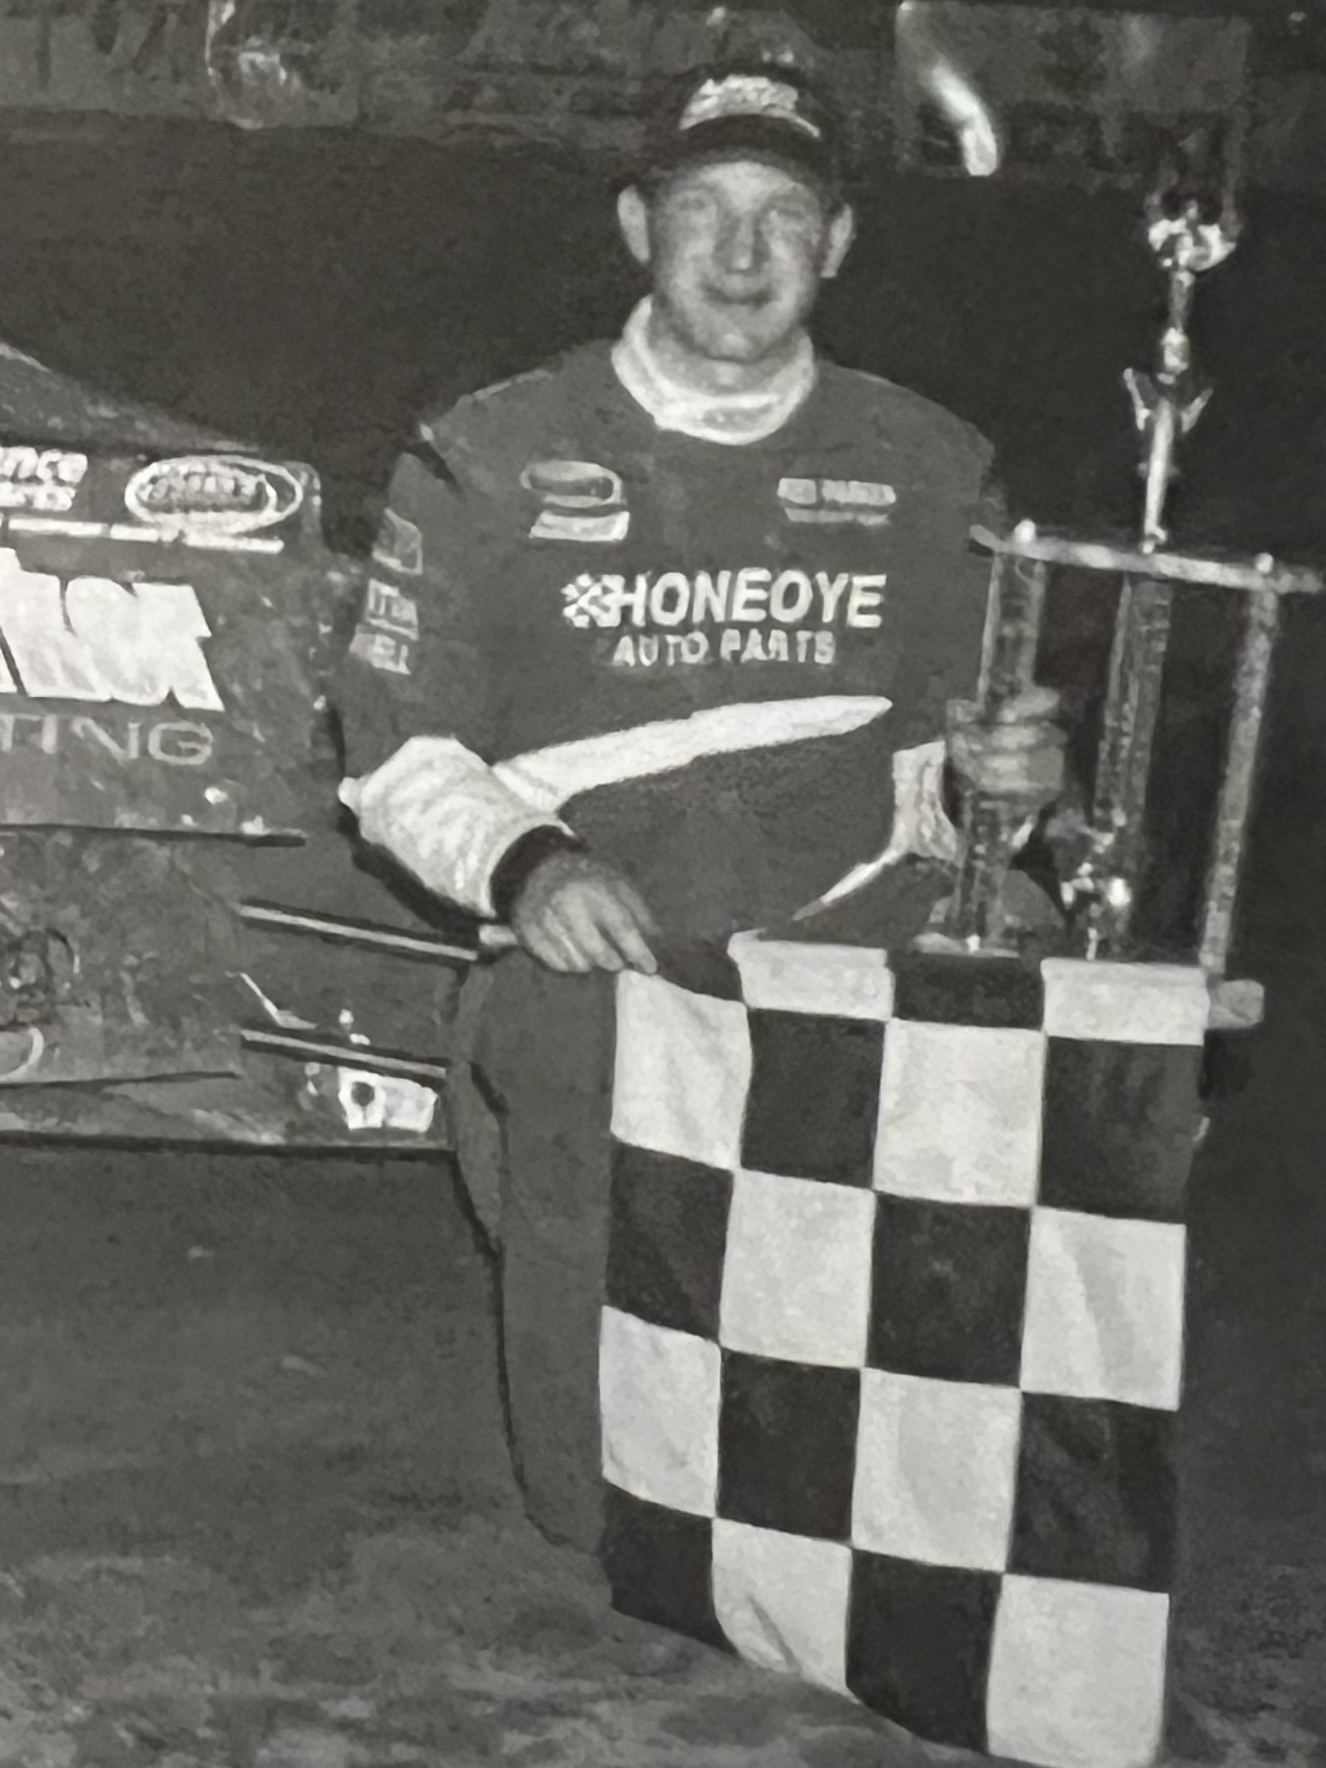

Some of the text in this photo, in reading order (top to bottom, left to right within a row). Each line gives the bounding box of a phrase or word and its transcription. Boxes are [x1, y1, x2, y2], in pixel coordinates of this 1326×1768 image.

[604, 567, 887, 628] HONEOYE
[612, 629, 836, 667] AUTO PARTS
